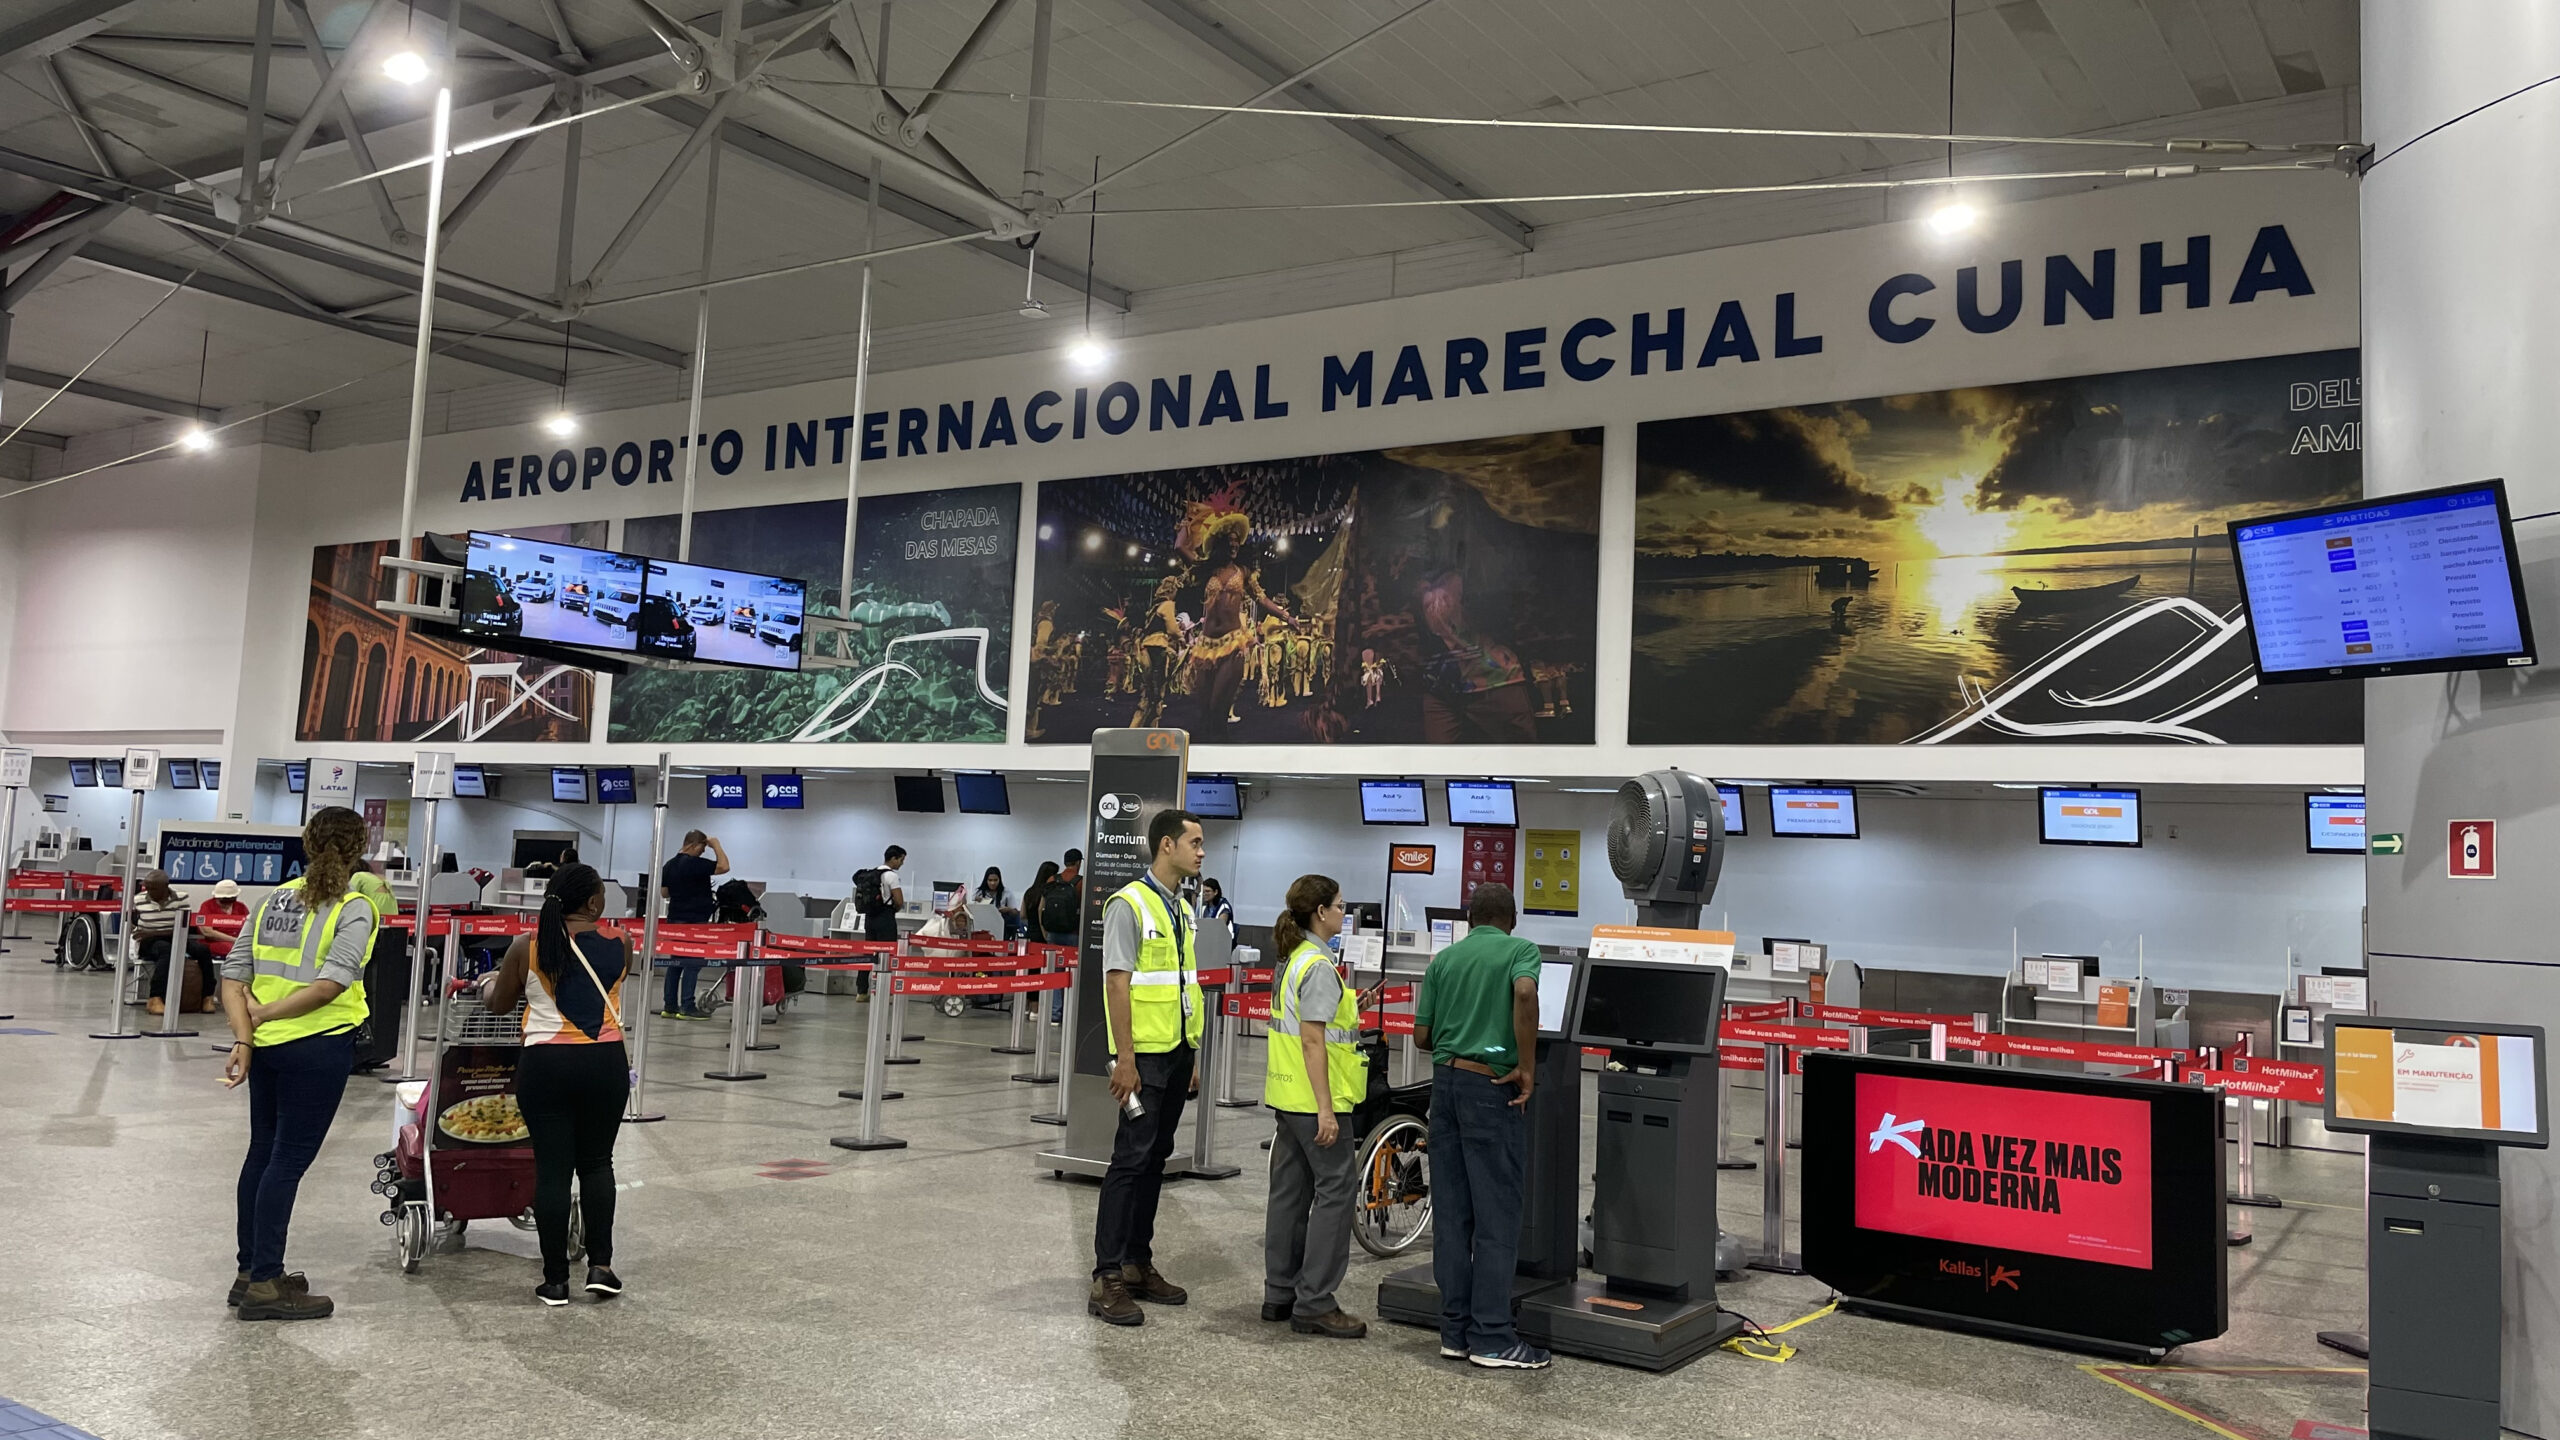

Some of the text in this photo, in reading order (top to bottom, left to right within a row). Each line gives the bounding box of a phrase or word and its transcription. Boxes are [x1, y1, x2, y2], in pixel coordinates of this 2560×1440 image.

[765, 363, 1289, 471] INTERNACIONAL
[1321, 291, 1823, 412] MARECHAL
[1868, 224, 2315, 344] CUNHA
[2290, 377, 2361, 411] DEL
[2291, 422, 2361, 455] AM
[921, 506, 1000, 531] CHAPADA
[2336, 509, 2390, 525] PARTIDAS
[905, 535, 998, 560] DAS MESAS
[1146, 732, 1179, 750] GOL
[613, 780, 630, 788] CCR
[723, 786, 742, 794] CCR
[779, 786, 798, 794] CCR
[1101, 801, 1117, 811] GOL
[2083, 807, 2100, 815] GOL
[167, 836, 284, 851] Atendimento preferencial
[1097, 832, 1147, 845] Premium
[1398, 851, 1429, 864] Smiles
[266, 916, 298, 932] 0032
[910, 983, 941, 992] HotMilhas
[2101, 987, 2114, 995] GOL
[1822, 1010, 1859, 1020] HotMilhas
[1384, 1018, 1415, 1028] hotmilhas
[1734, 1027, 1756, 1036] Venda
[1773, 1031, 1797, 1040] milhas
[1817, 1034, 1849, 1042] hotmilhas
[1945, 1035, 1982, 1047] tMilhas
[2008, 1041, 2031, 1050] Venda
[2051, 1045, 2075, 1054] milhas
[1720, 1053, 1764, 1065] tmilhas.com
[2261, 1065, 2315, 1080] HotMilhas
[2412, 1069, 2473, 1081] MANUTENÇÃO
[2221, 1079, 2280, 1094] HotMilhas
[1981, 1133, 2037, 1174] VEZ
[2045, 1141, 2122, 1185] MAIS
[1918, 1161, 2061, 1215] MODERNA
[1939, 1258, 1982, 1277] Kallas
